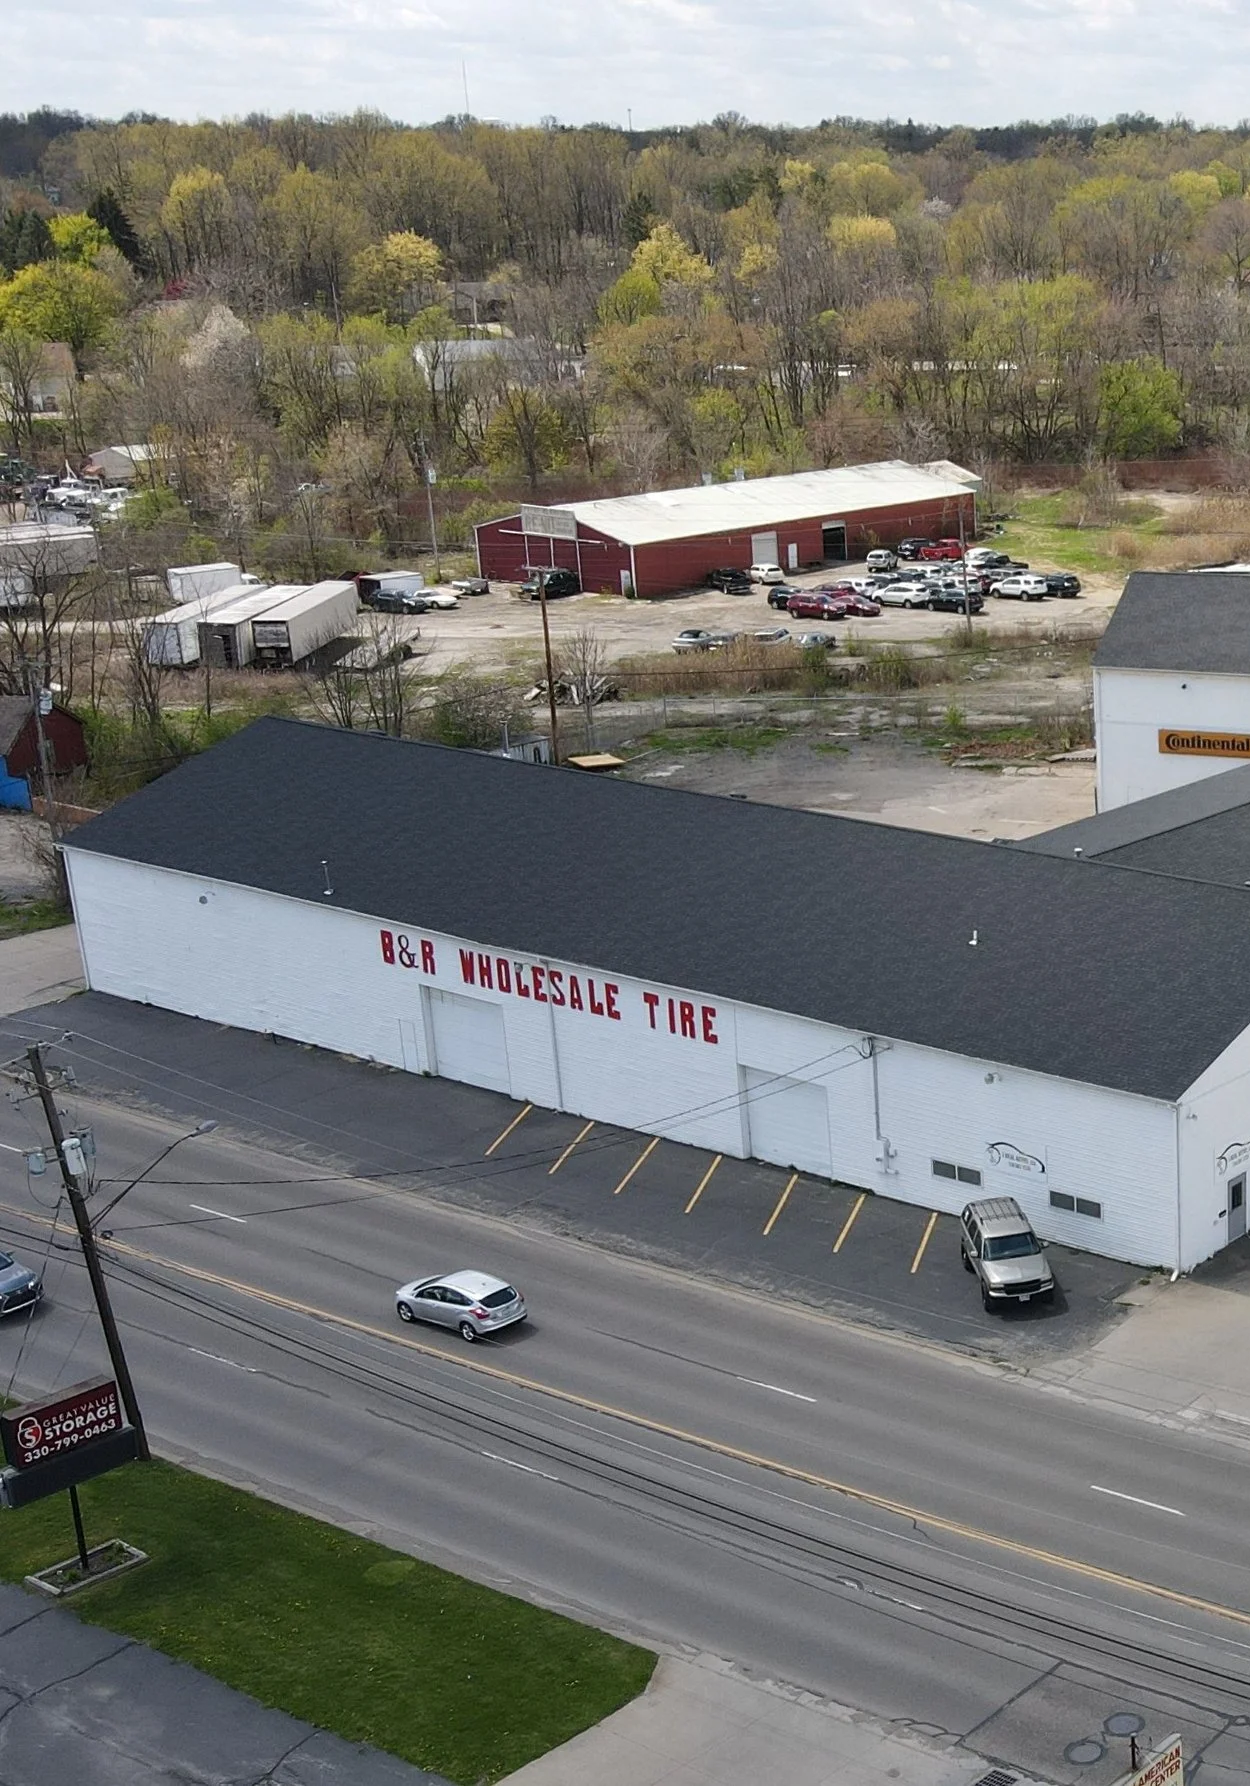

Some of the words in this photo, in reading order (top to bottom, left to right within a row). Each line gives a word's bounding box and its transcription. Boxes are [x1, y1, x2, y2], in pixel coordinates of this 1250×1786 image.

[1165, 733, 1250, 751] Continental
[380, 930, 436, 975] B&R
[459, 949, 621, 1020] WHOLESALE
[643, 992, 718, 1044] TIRE
[43, 1408, 78, 1428] GREAT
[80, 1393, 115, 1412] VALUE
[44, 1403, 117, 1440] STORAGE
[24, 1419, 116, 1463] 330-799-0463
[1139, 1745, 1180, 1786] AMERICAN
